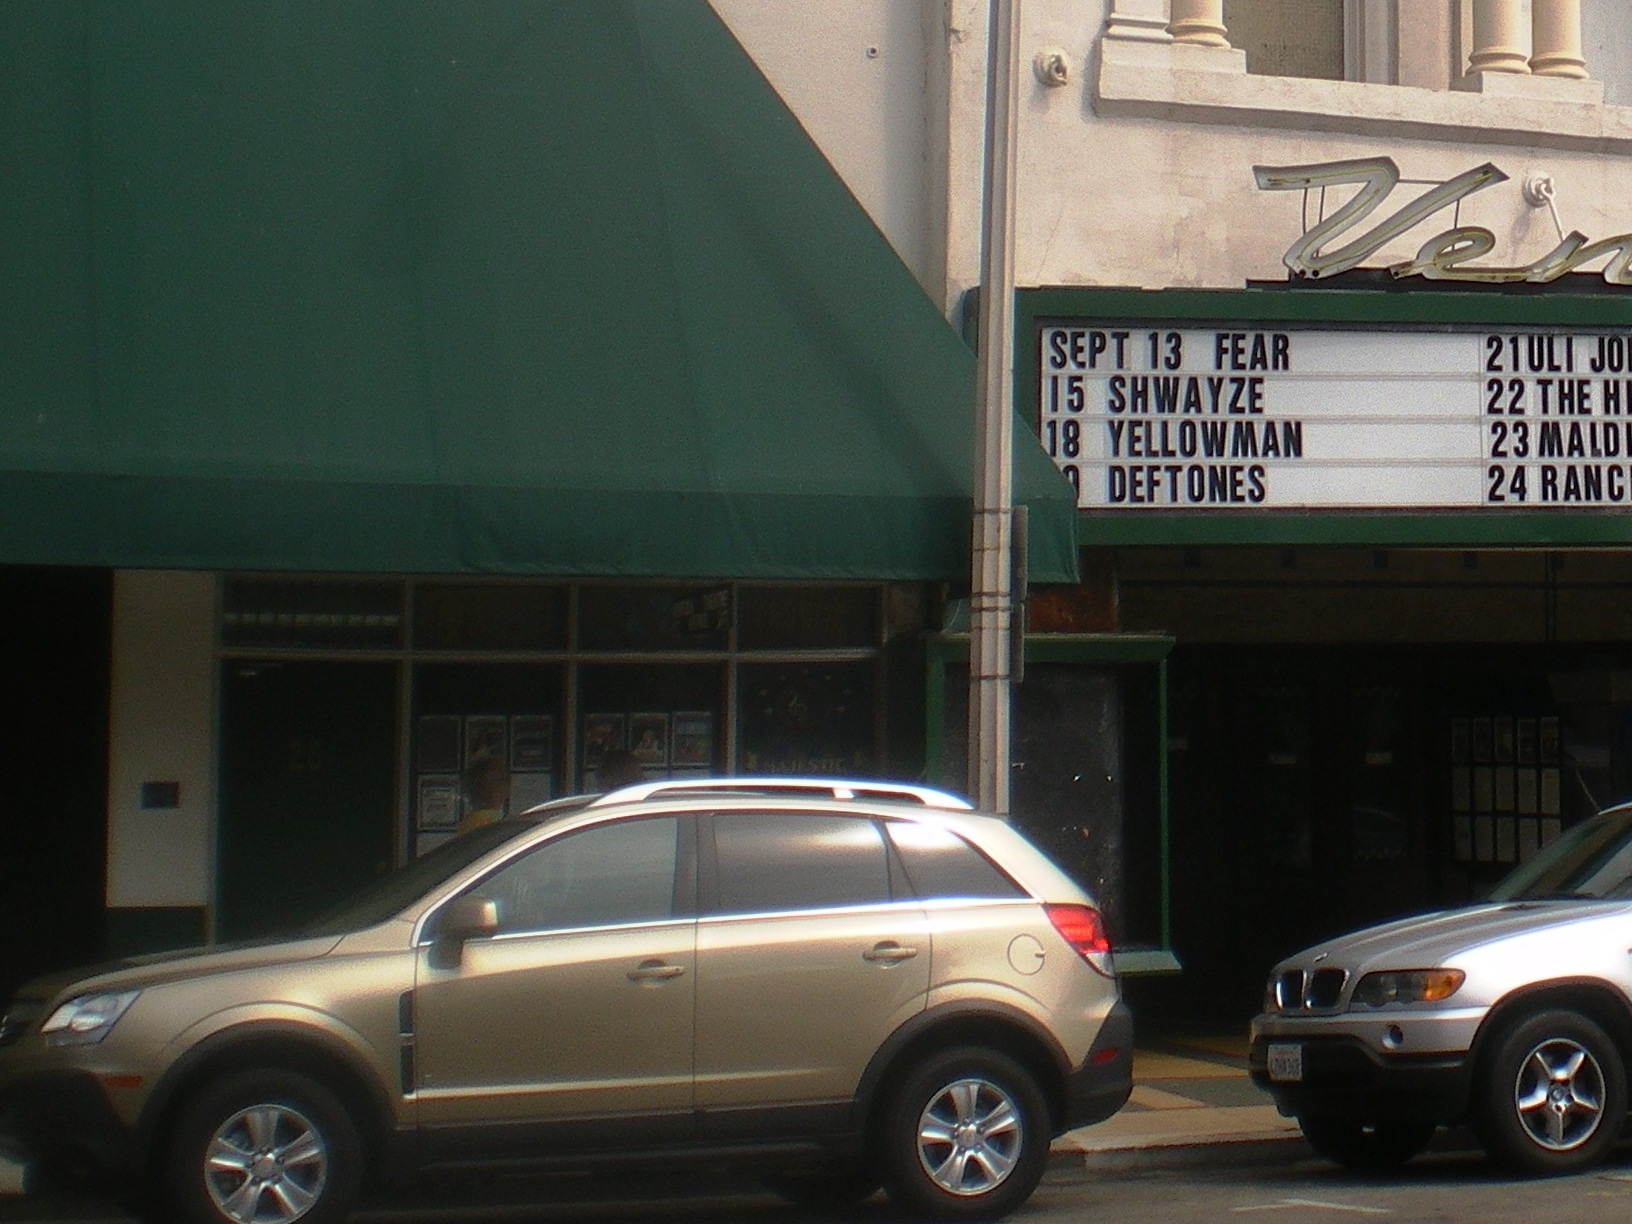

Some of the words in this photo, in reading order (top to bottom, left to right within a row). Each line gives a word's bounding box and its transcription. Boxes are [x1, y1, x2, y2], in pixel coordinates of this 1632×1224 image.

[1049, 330, 1130, 370] SEPT
[1148, 331, 1183, 371] 13
[1215, 332, 1290, 372] FEAR
[1486, 334, 1520, 373] 21
[1527, 335, 1574, 373] ULI
[1050, 375, 1085, 414] 15
[1107, 375, 1265, 414] SHWAYZE
[1486, 377, 1526, 416] 22
[1536, 378, 1592, 416] THE
[1046, 418, 1081, 459] 18
[1107, 418, 1303, 459] YELLOWMAN
[1490, 419, 1530, 459] 23
[1107, 464, 1266, 504] DEFTONES
[1487, 463, 1528, 503] 24
